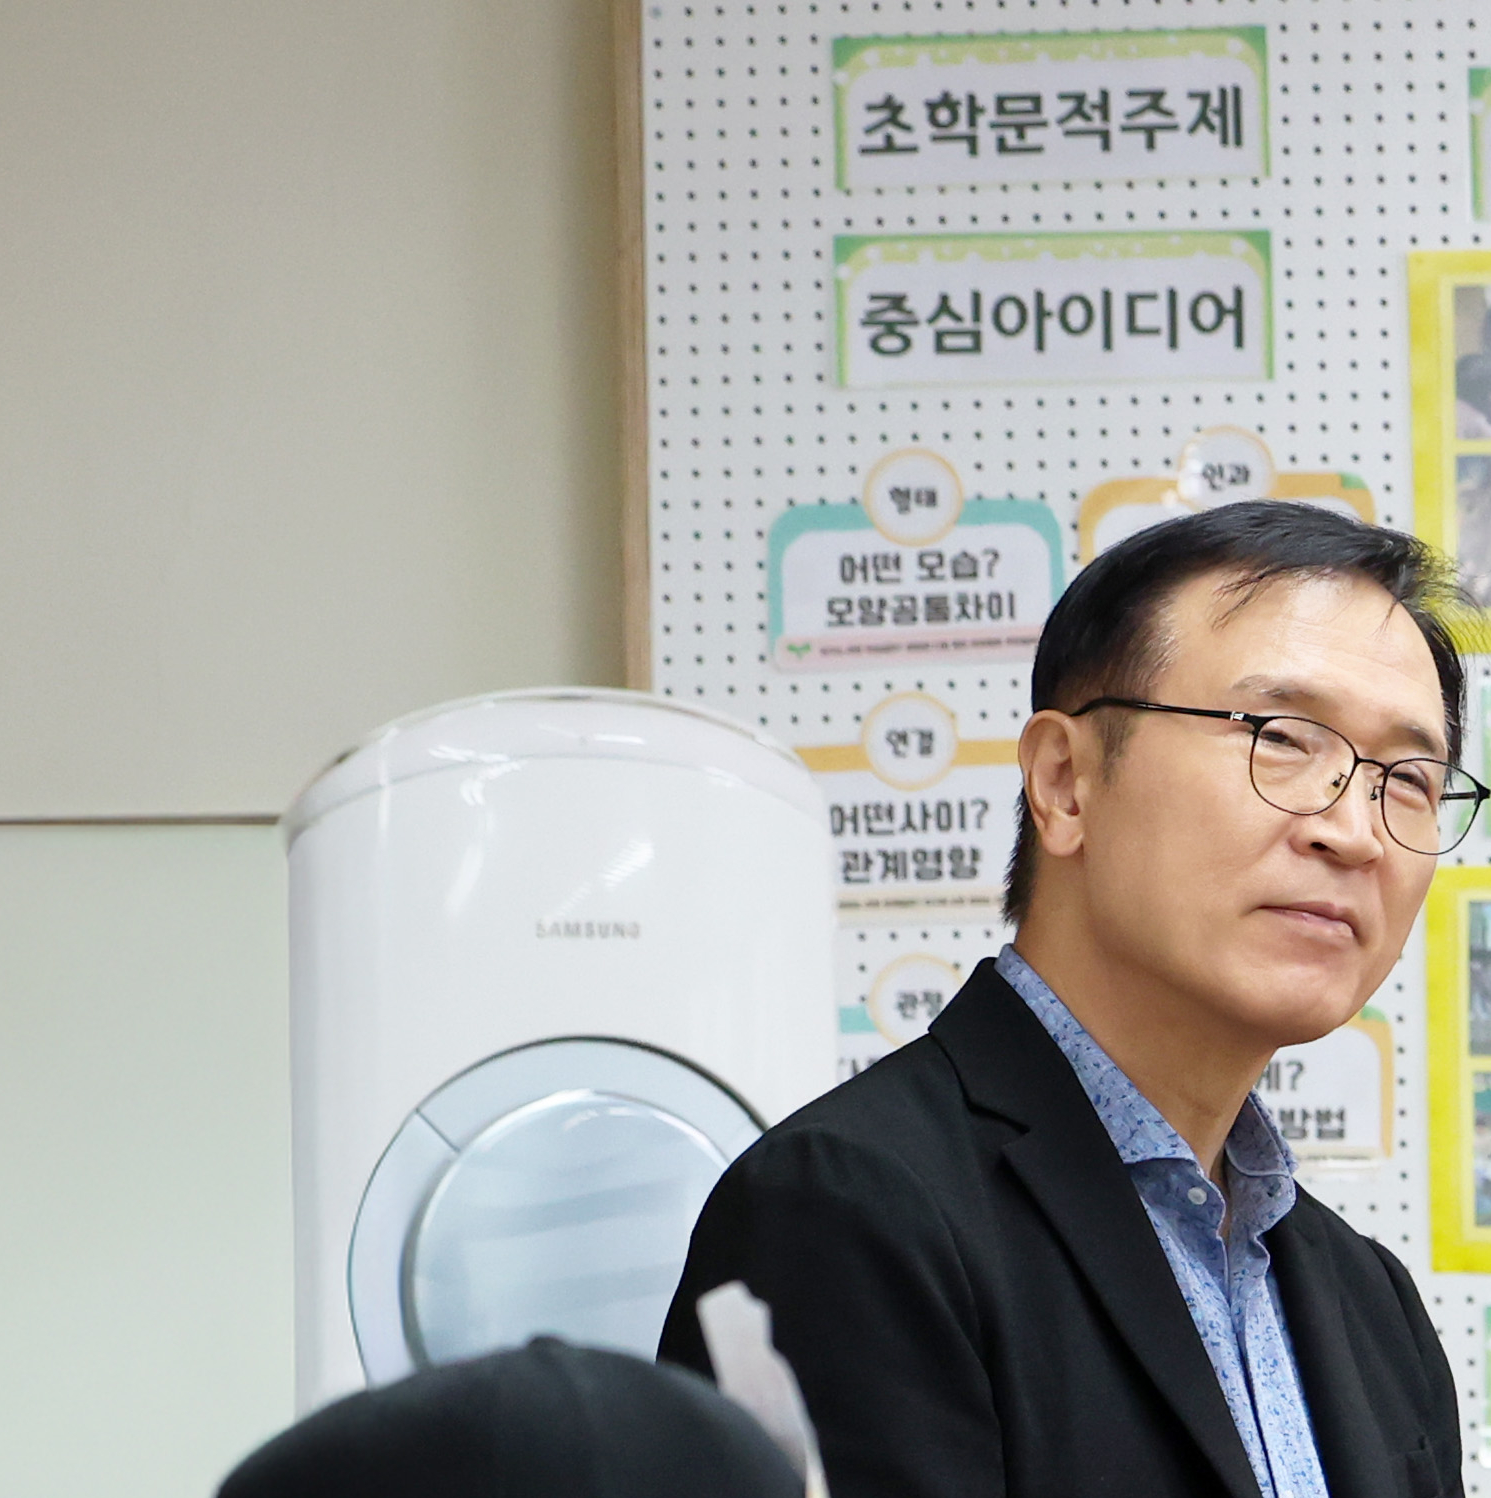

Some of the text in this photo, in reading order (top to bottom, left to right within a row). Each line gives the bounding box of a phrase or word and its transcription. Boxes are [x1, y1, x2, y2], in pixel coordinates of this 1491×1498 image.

[858, 85, 1245, 159] 초학문적주제
[860, 286, 1247, 356] 중심아이디어
[839, 549, 1001, 584] 어떤 모습?
[838, 845, 982, 885] 관계영향
[535, 919, 641, 939] SAMSUNG
